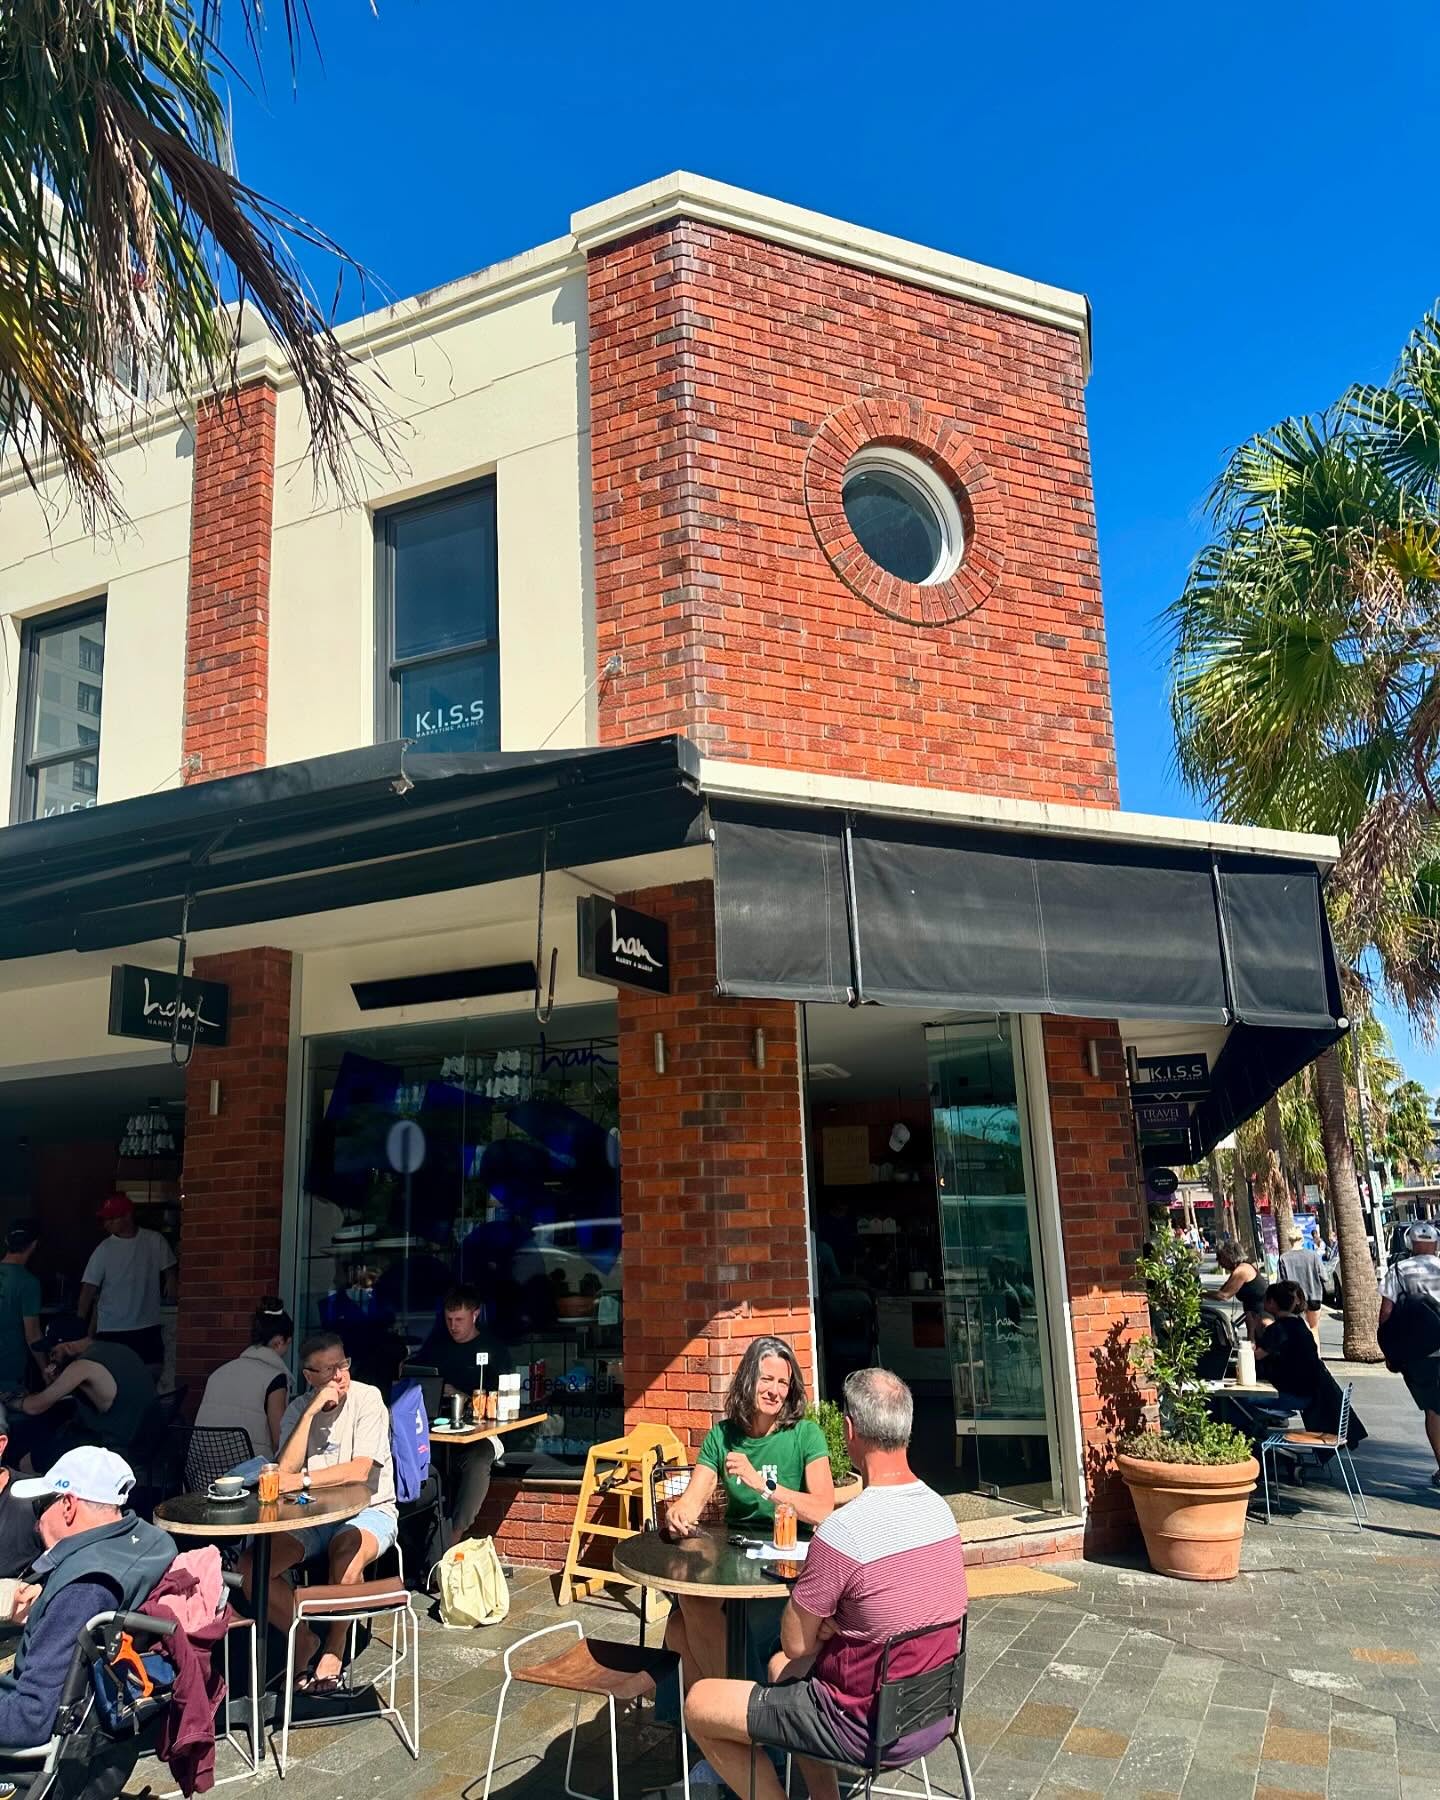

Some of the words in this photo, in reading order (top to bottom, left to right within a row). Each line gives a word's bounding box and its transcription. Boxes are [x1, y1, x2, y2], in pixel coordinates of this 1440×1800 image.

[416, 700, 484, 732] K.I.S.S
[610, 908, 663, 967] ham
[1149, 1064, 1203, 1080] K.I.S.S
